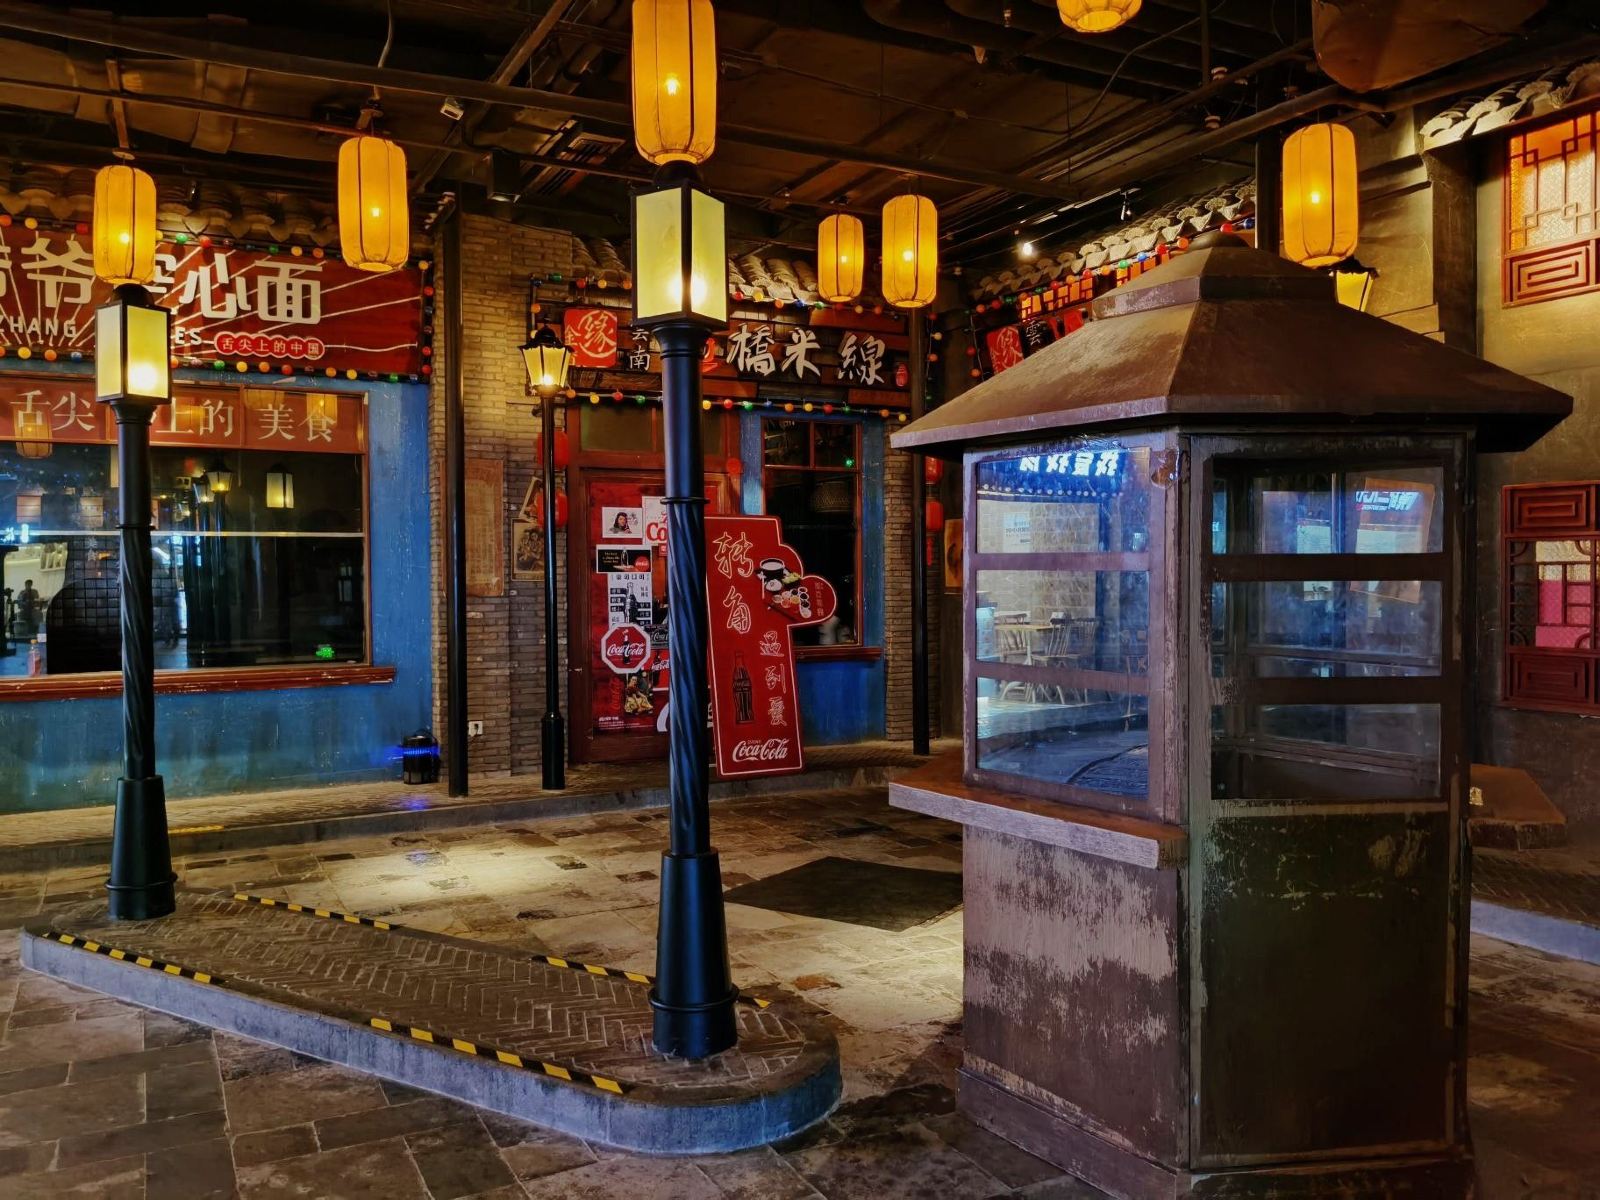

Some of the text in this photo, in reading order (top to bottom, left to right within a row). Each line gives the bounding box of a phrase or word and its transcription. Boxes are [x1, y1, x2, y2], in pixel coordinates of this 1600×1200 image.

[221, 336, 320, 356] 舌尖上的中国
[702, 322, 886, 385] 橋米線
[732, 738, 790, 763] Coca-Cola
